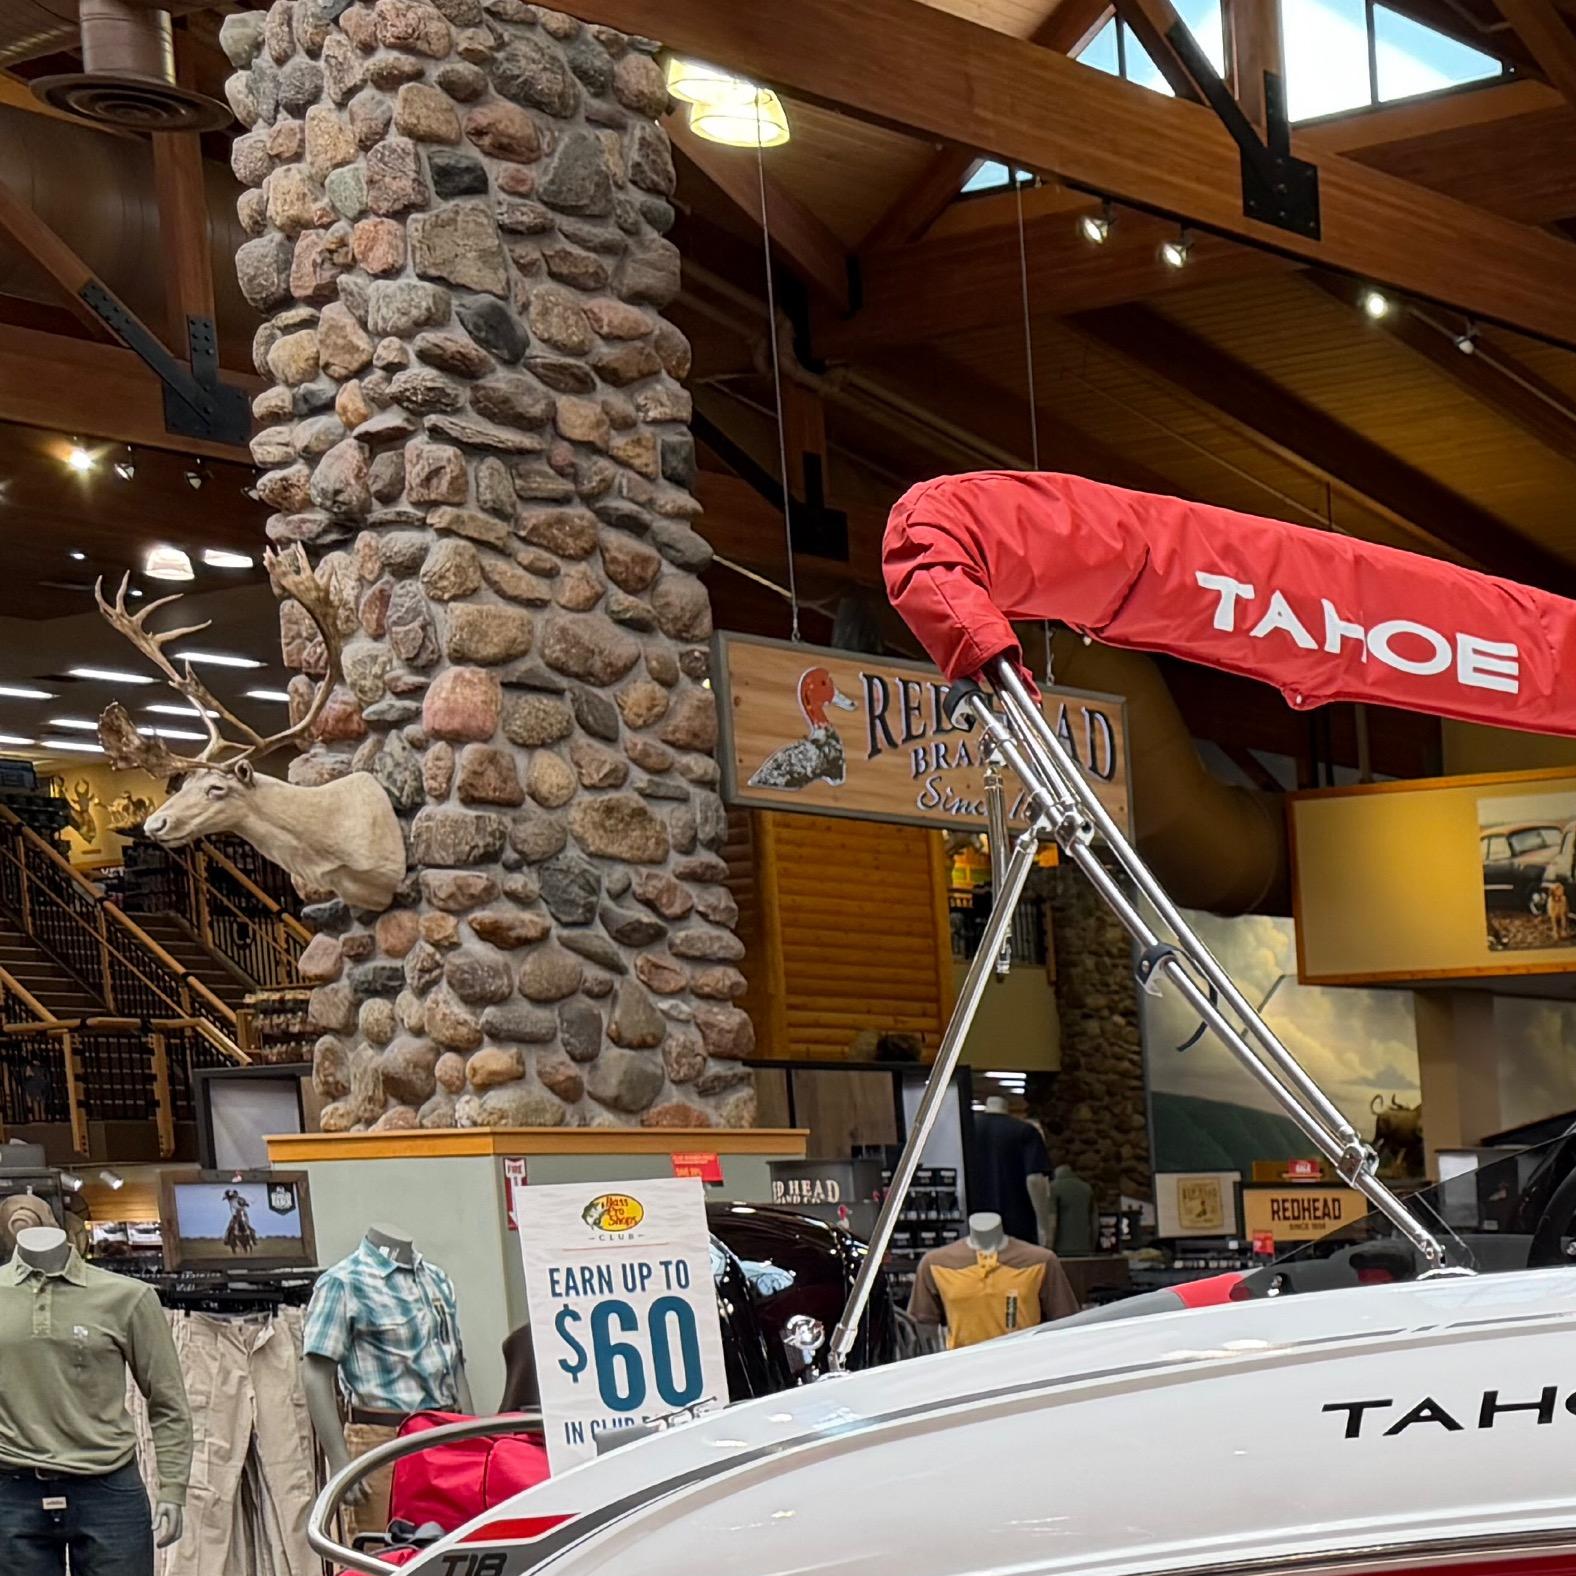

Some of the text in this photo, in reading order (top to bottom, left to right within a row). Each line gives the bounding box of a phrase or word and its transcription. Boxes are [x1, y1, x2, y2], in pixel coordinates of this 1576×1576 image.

[1195, 570, 1519, 694] TAHOE
[916, 776, 985, 817] Sinc
[1271, 1197, 1342, 1221] REDHEAD
[599, 1233, 635, 1242] CLUB
[549, 1259, 691, 1298] EARN UP TO
[554, 1296, 704, 1413] $60
[564, 1420, 585, 1446] IN
